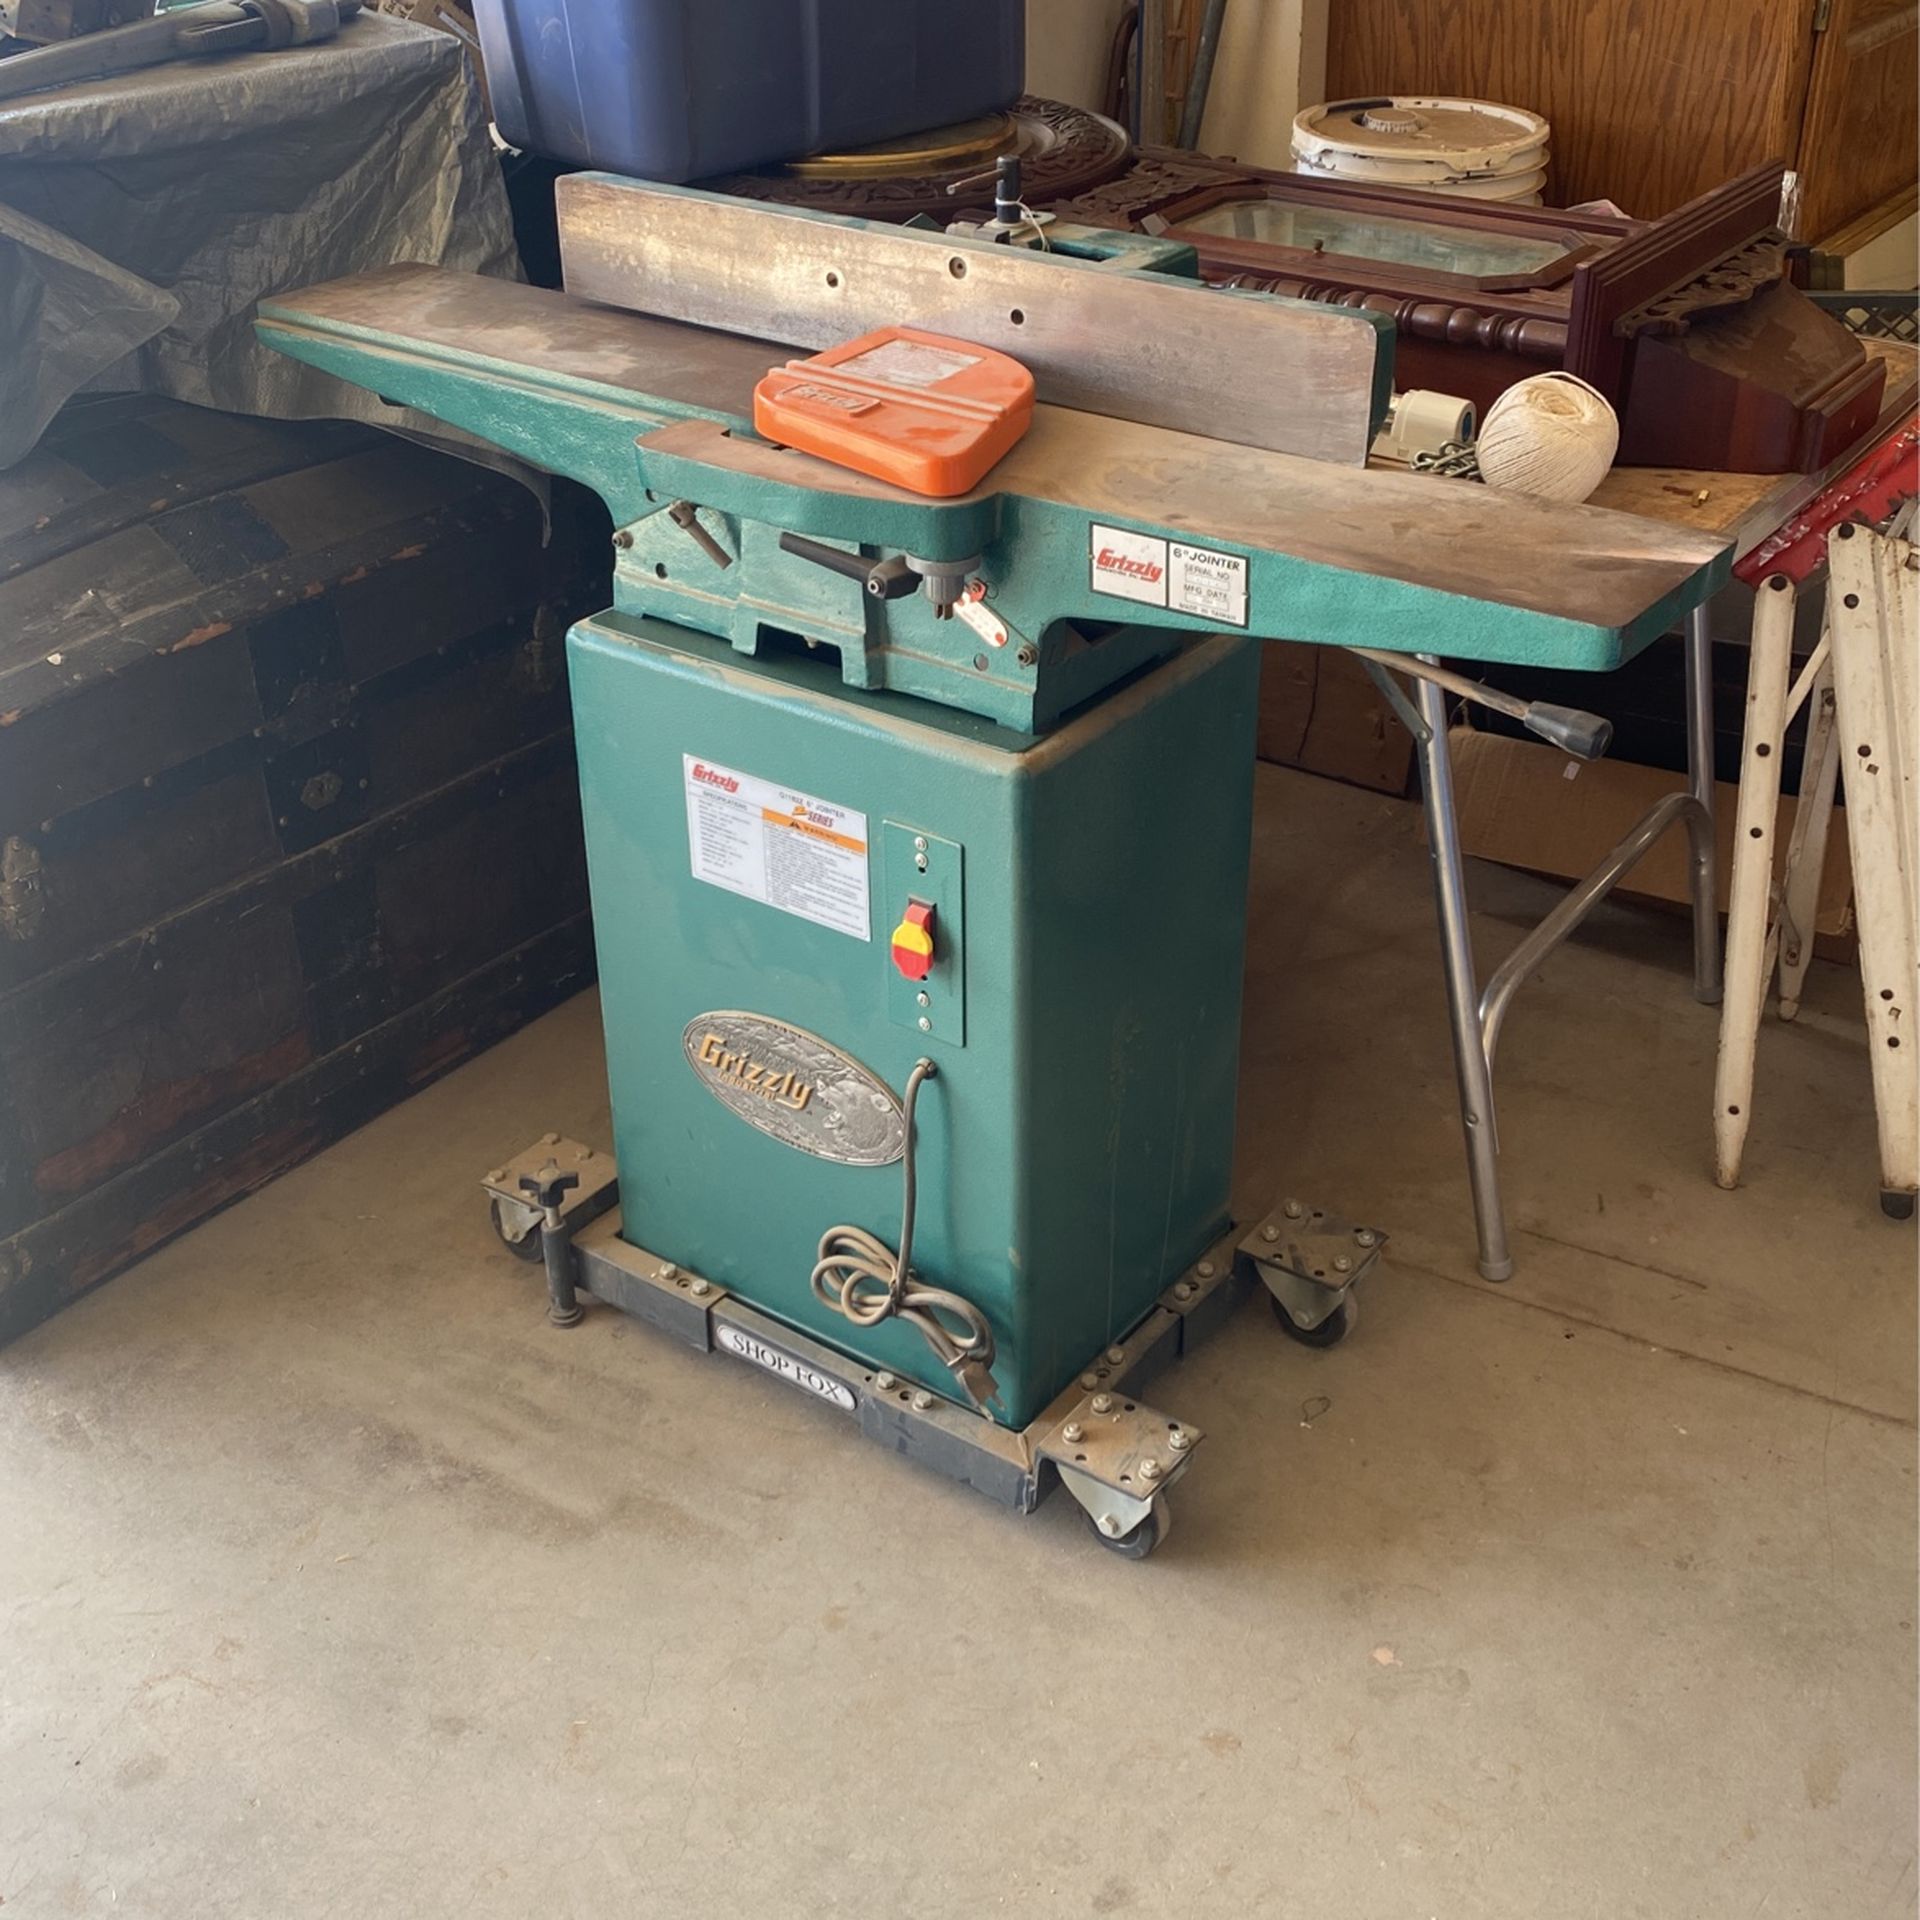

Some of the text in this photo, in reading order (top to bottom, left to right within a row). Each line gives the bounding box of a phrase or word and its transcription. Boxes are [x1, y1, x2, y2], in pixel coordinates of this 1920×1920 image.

[1096, 548, 1164, 583] Grizzly
[1184, 563, 1213, 577] SERIAL
[1189, 552, 1240, 571] JOINTER
[1206, 589, 1228, 600] DATE
[692, 763, 740, 794] Grizzly
[808, 811, 834, 828] SERIES
[698, 1033, 814, 1110] Grizzly
[733, 1334, 839, 1400] SHOP FOX
